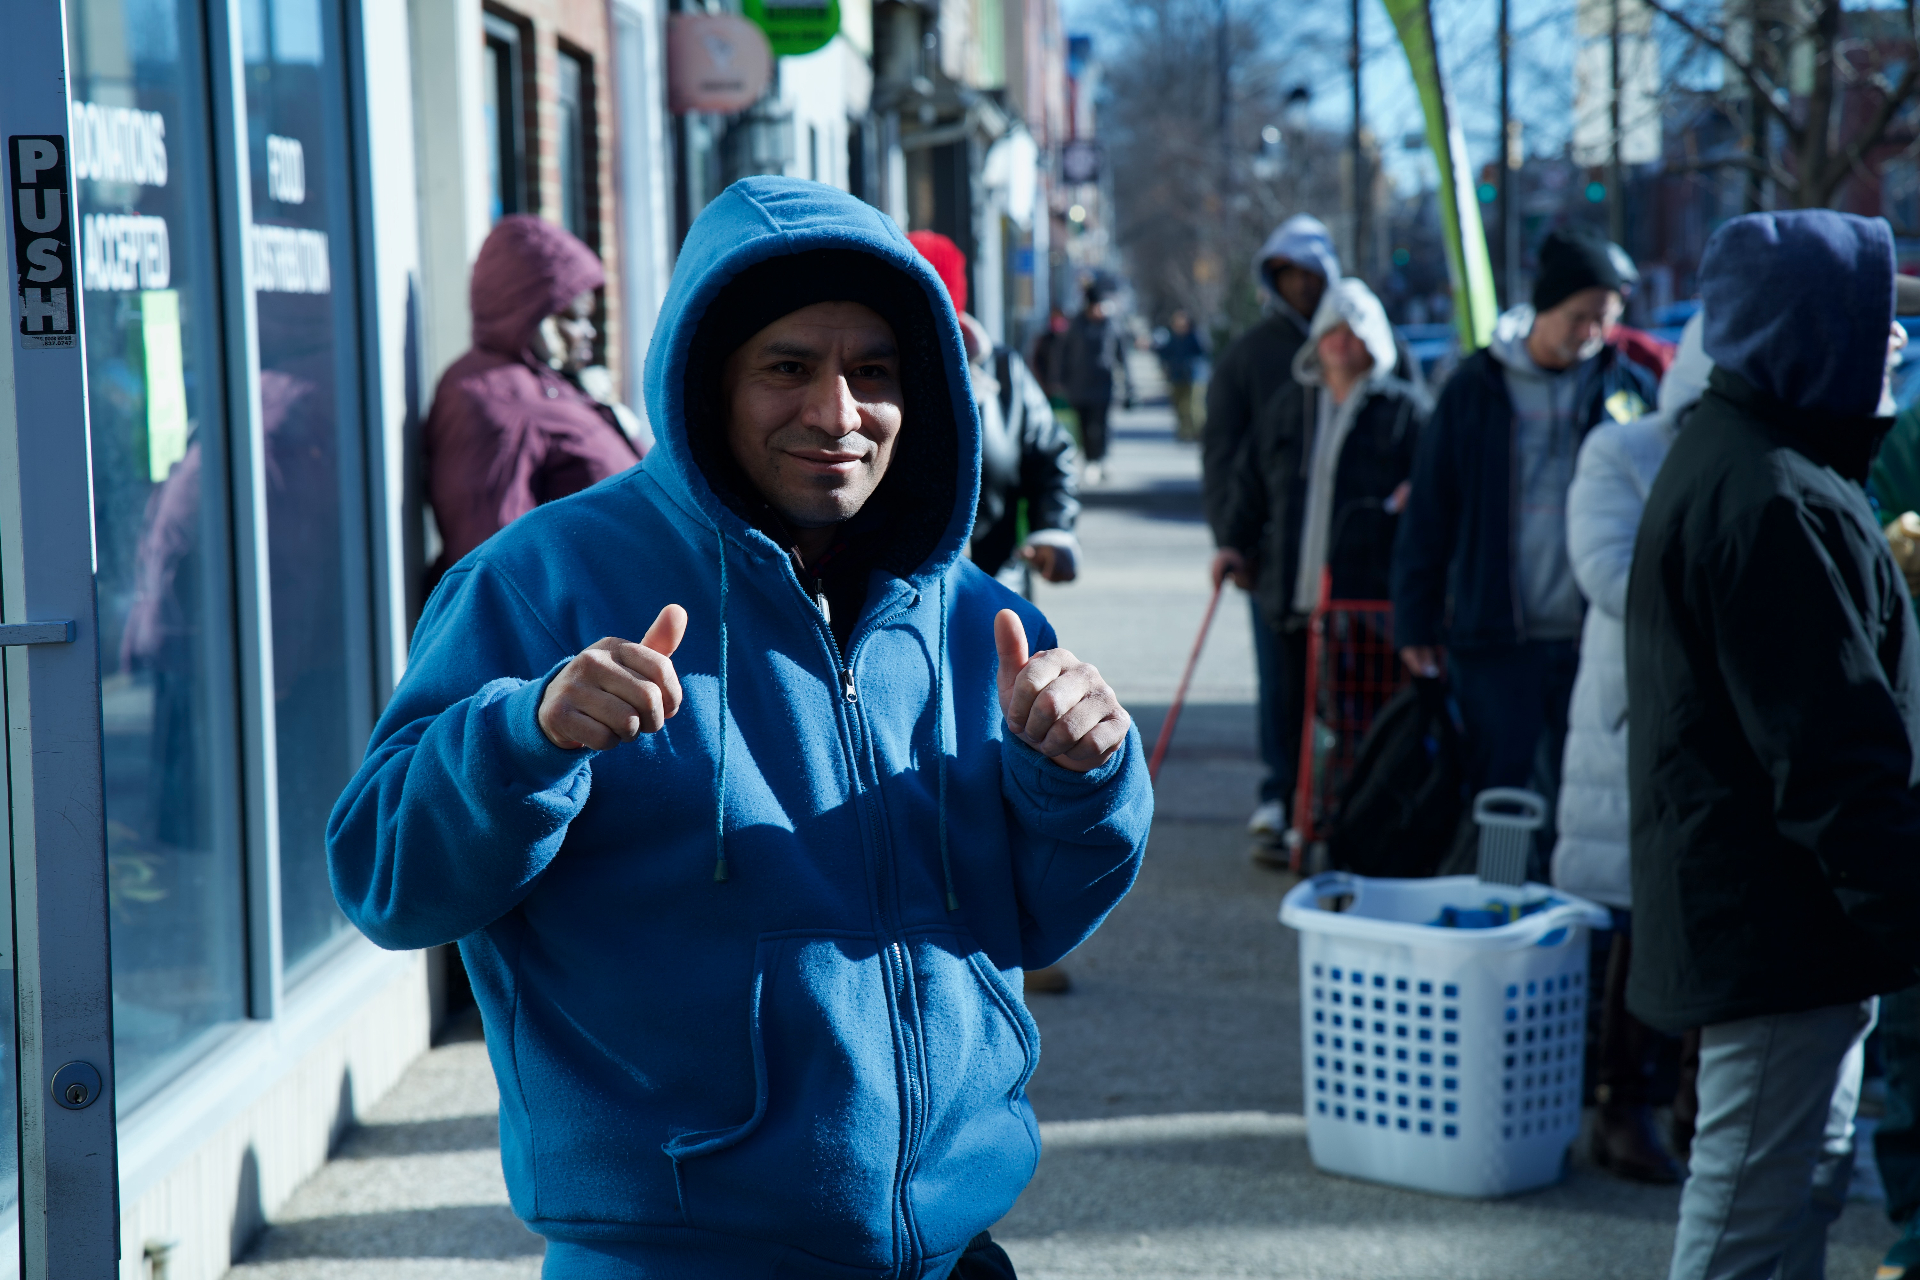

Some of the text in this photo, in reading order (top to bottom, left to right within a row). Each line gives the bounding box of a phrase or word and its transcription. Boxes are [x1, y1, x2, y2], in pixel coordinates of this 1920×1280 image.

[73, 102, 168, 187] DONATIONS
[266, 134, 305, 205] FOOD
[19, 139, 69, 332] PUSH
[84, 213, 170, 291] ACCEPTED
[252, 223, 331, 294] DISTRIBUTION
